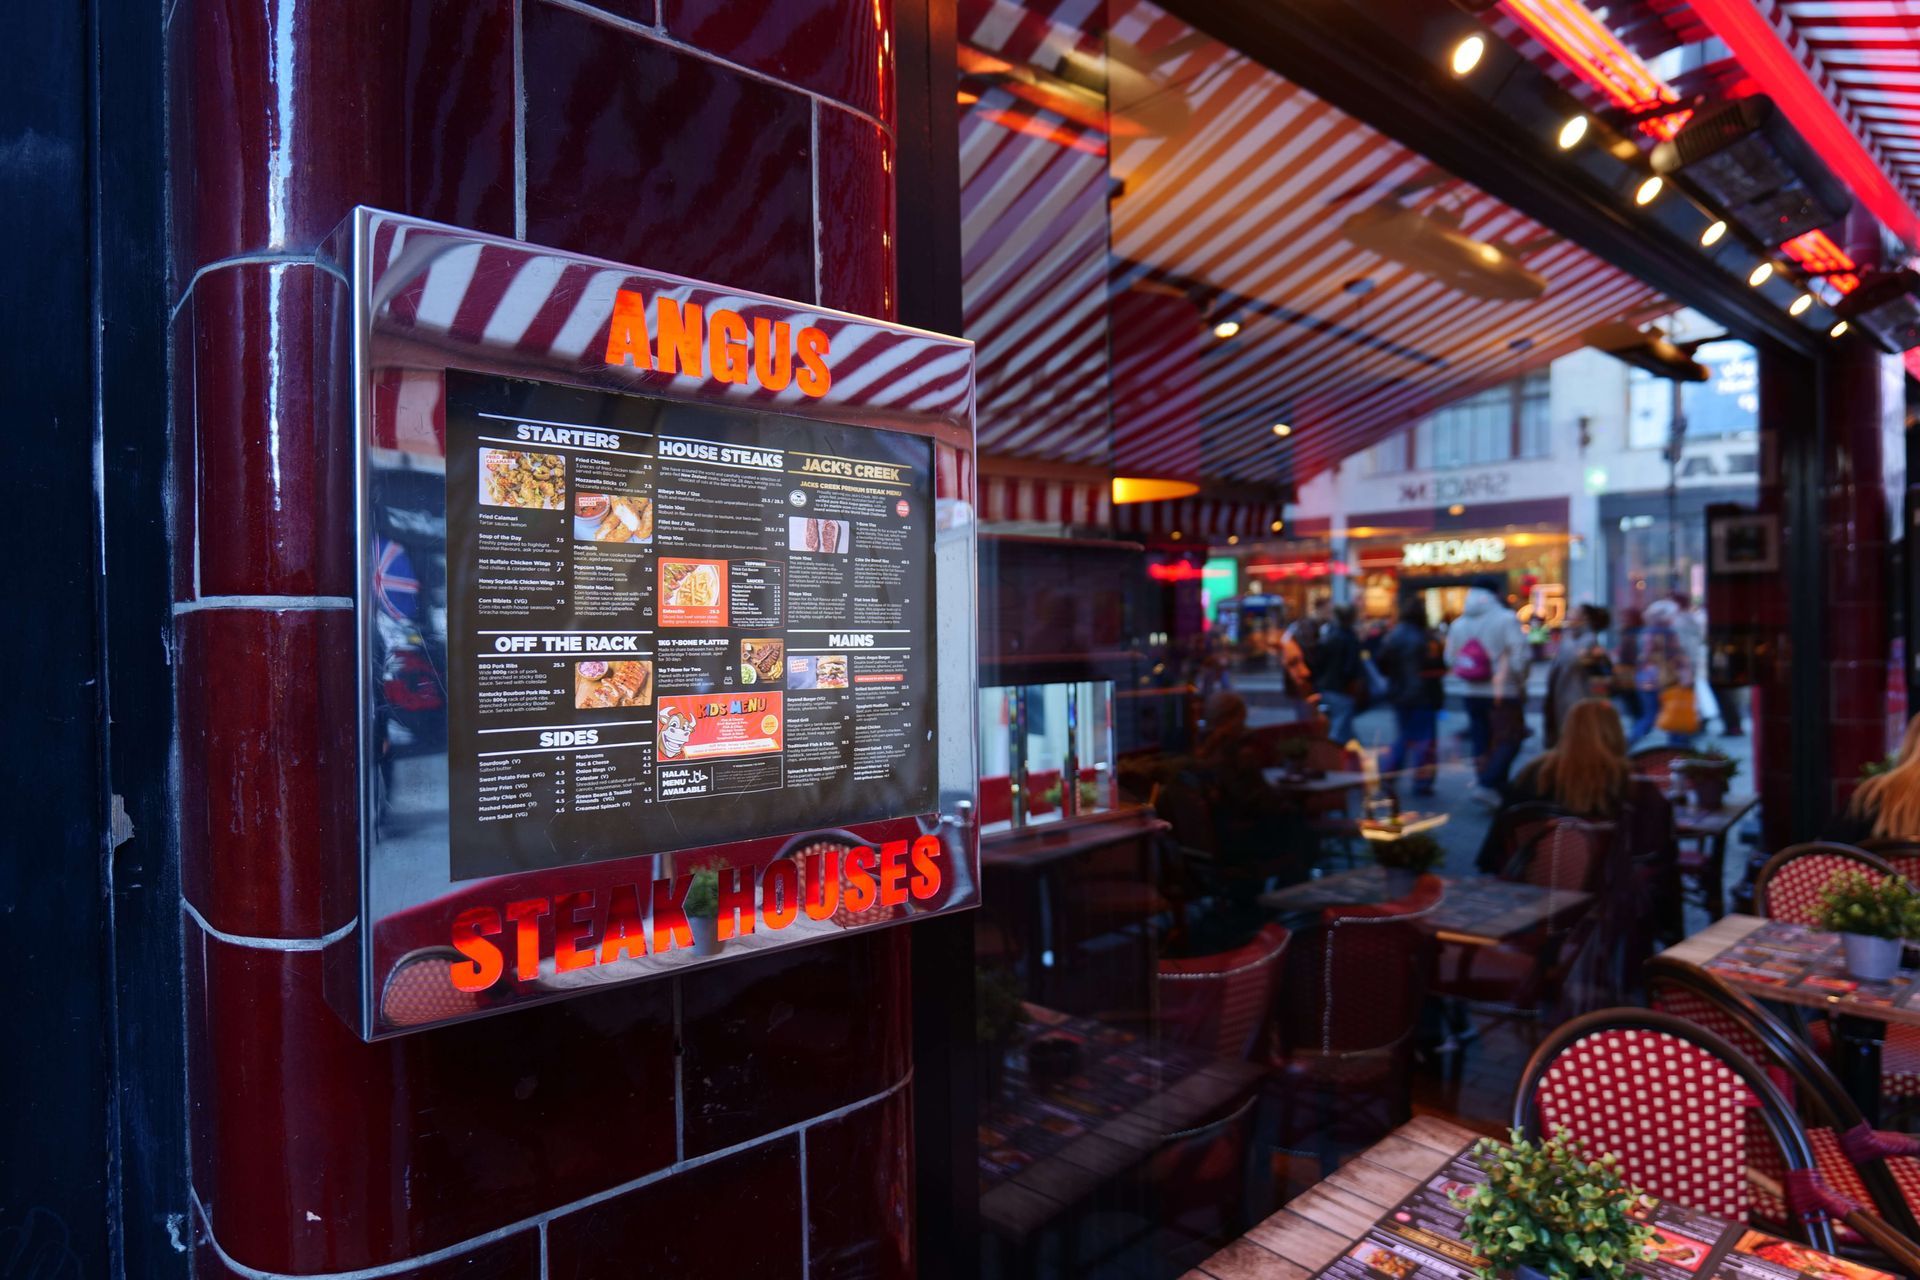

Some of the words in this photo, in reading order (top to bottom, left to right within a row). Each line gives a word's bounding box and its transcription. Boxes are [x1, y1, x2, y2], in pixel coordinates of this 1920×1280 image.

[605, 289, 831, 398] ANGUS
[516, 424, 620, 450] STARTERS
[659, 440, 718, 460] HOUSE
[720, 448, 783, 468] STEAKS
[802, 458, 853, 476] JACK'S
[854, 464, 900, 481] CREEK
[841, 484, 865, 493] PREMIUM
[866, 487, 885, 495] STEAK
[495, 636, 538, 652] OFF
[542, 636, 582, 651] THE
[586, 636, 637, 651] RACK
[829, 634, 874, 647] MAINS
[698, 703, 727, 719] KIDS
[730, 698, 767, 715] MENU
[540, 729, 599, 747] SIDES
[662, 770, 690, 778] HALAL
[662, 778, 686, 787] MENU
[662, 785, 707, 796] AVAILABLE
[450, 908, 694, 992] STEAK
[719, 834, 943, 943] HOUSES
